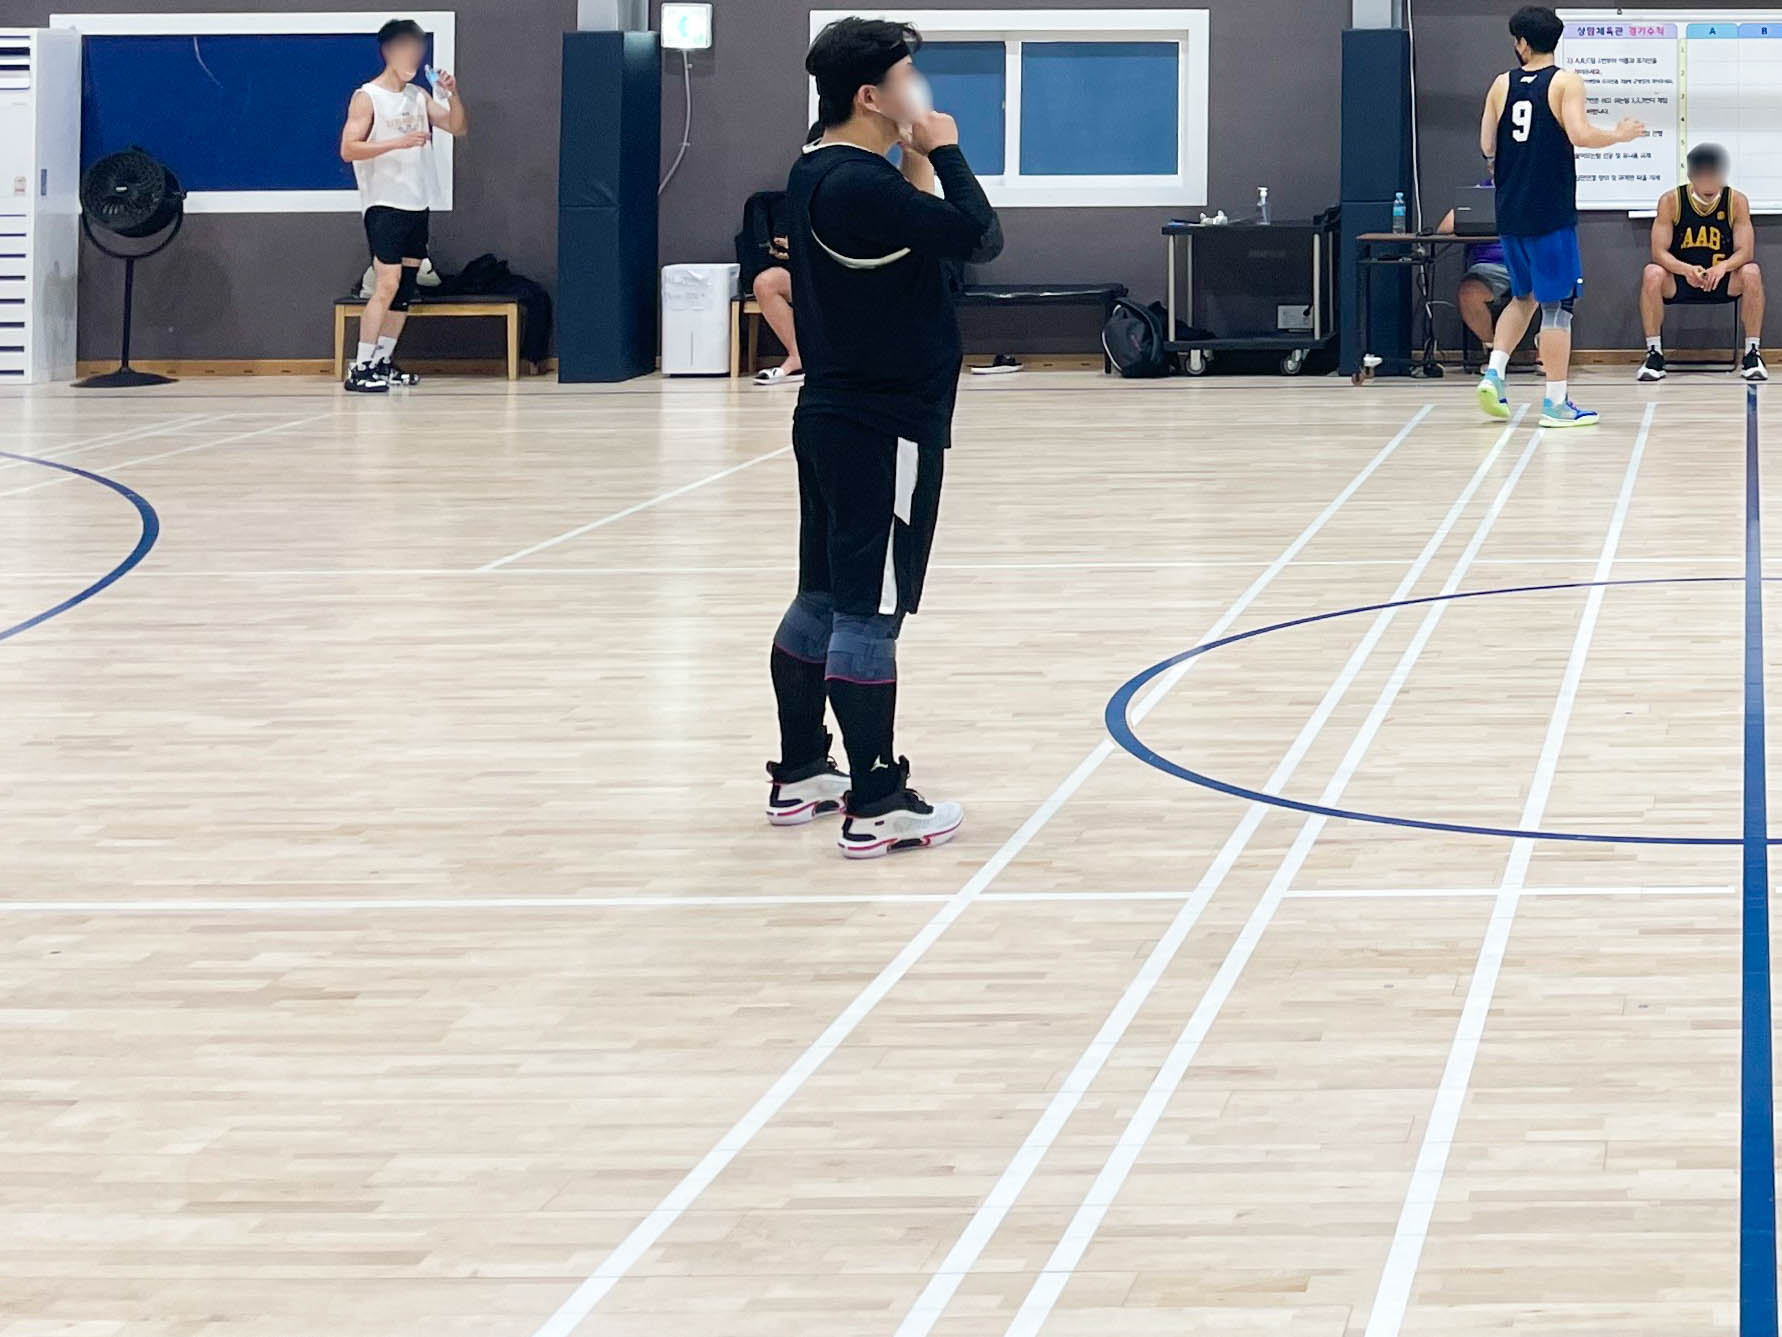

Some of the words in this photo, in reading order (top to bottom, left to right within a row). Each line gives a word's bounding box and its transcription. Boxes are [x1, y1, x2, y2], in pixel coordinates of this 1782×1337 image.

[1708, 27, 1716, 35] A
[1761, 27, 1768, 35] B
[1512, 100, 1532, 142] 9
